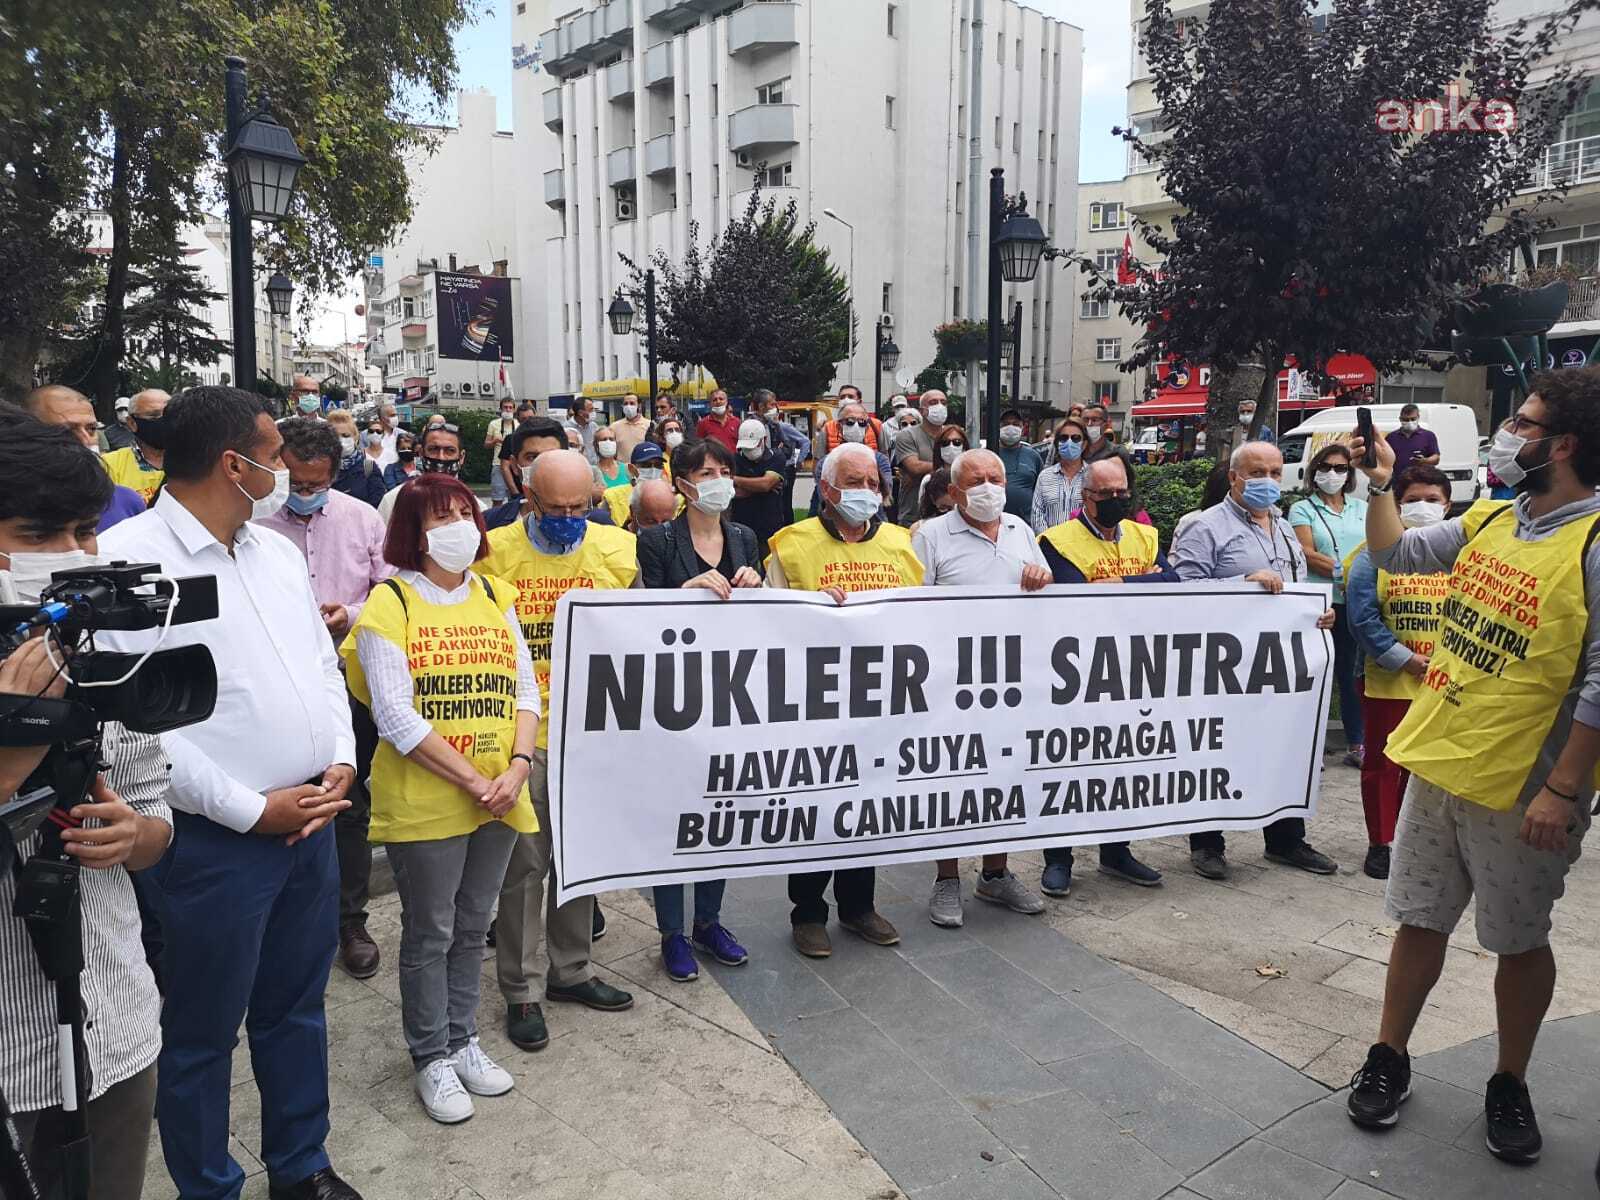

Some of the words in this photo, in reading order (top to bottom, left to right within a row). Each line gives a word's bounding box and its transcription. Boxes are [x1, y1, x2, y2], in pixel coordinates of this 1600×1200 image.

[1468, 550, 1486, 564] NE
[824, 562, 840, 573] NE
[842, 561, 895, 572] SİNOP'TA
[1454, 561, 1472, 576] NE
[516, 579, 534, 589] NE
[820, 574, 834, 585] NE
[838, 572, 900, 584] AKKUYU'DA
[1404, 587, 1417, 596] DE
[1461, 580, 1476, 596] DE
[525, 604, 541, 615] DE
[1390, 599, 1432, 615] NÜKLEER
[418, 626, 440, 638] NE
[445, 624, 509, 641] SİNOP'TA
[411, 640, 433, 654] NE
[438, 638, 514, 656] AKKUYU'DA
[409, 655, 428, 670] NE
[433, 653, 454, 666] DE
[459, 651, 517, 671] DÜNYA'DA
[584, 628, 930, 731] NÜKLEER
[955, 635, 1022, 710] !!!
[1051, 631, 1315, 705] SANTRAL
[1425, 665, 1449, 691] KP
[421, 697, 505, 720] İSTEMİYORUZ
[442, 735, 473, 754] KP
[706, 744, 860, 793] HAVAYA
[898, 733, 988, 776] SUYA
[1025, 708, 1177, 765] TOPRAĞA
[1188, 717, 1224, 752] VE
[676, 797, 818, 849] BÜTÜN
[834, 784, 1027, 839] CANLILARA
[1039, 767, 1243, 817] ZARARLIDIR.
